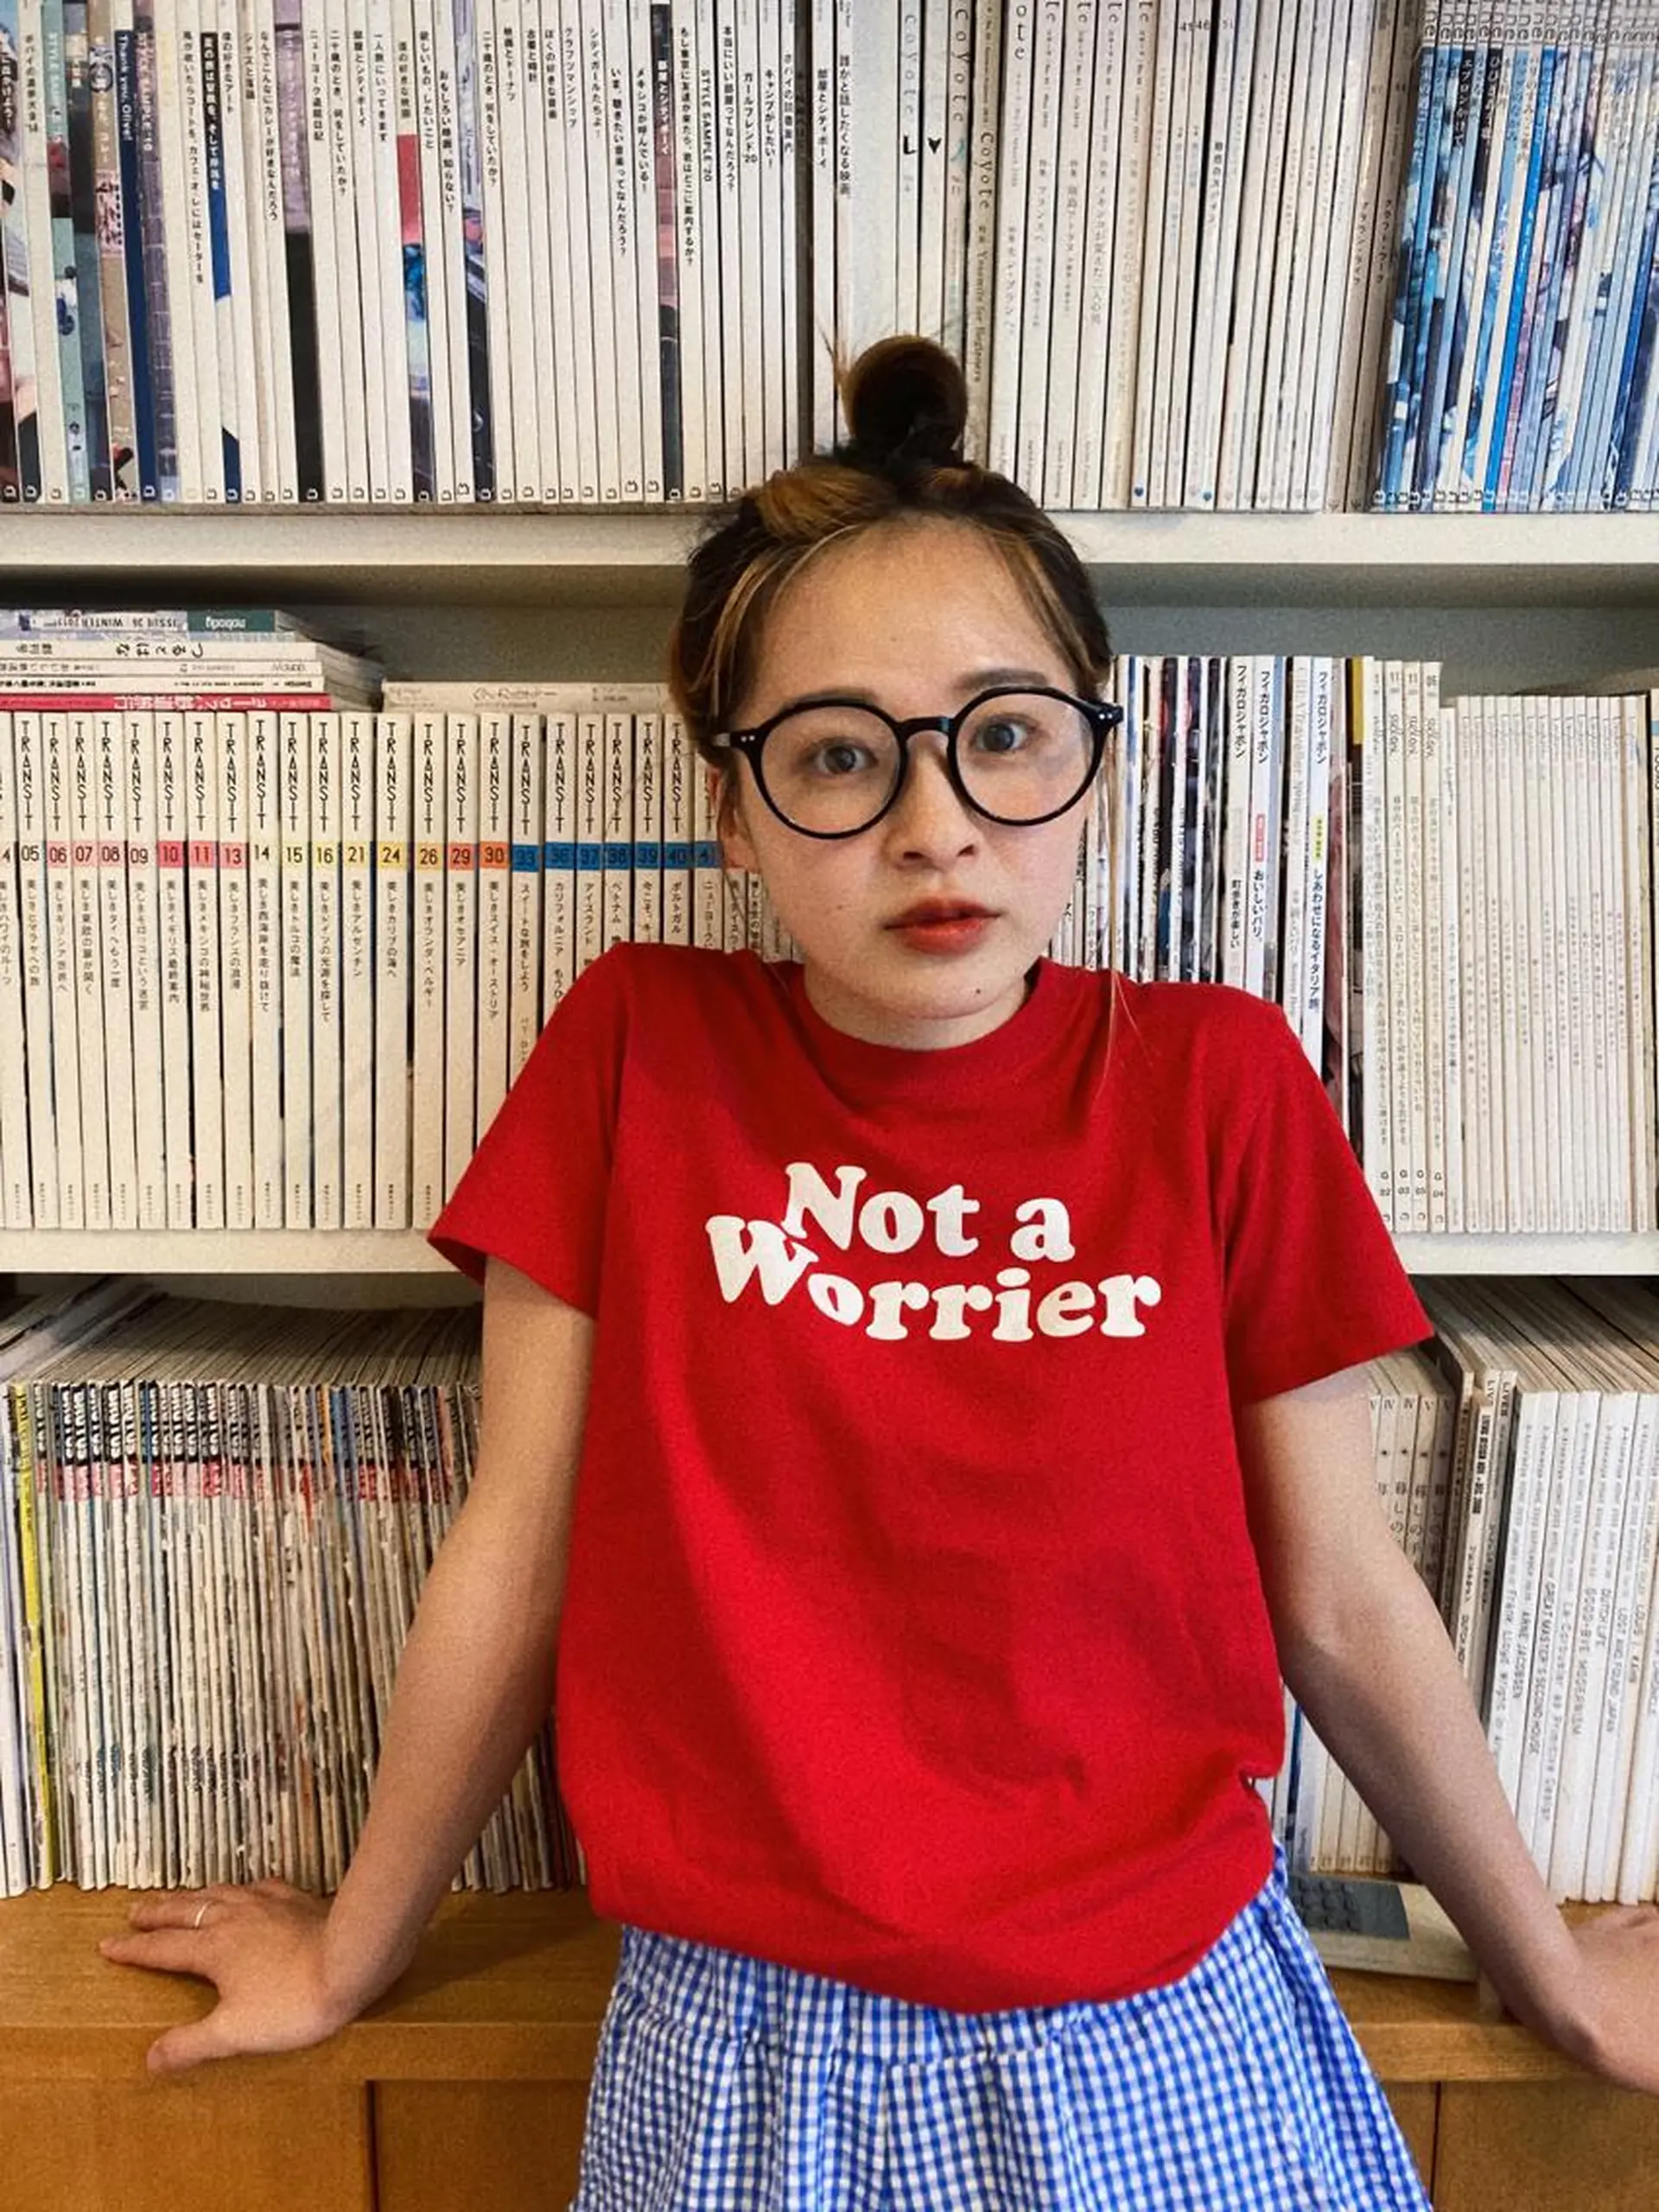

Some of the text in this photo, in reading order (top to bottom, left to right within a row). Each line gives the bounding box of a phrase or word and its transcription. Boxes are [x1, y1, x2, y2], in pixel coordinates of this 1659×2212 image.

[118, 35, 128, 76] Thank
[952, 8, 969, 123] Coyote
[122, 104, 133, 142] Olive!
[702, 111, 713, 162] SAMPLE
[974, 132, 994, 210] Coyote
[81, 618, 124, 628] WINTER
[115, 641, 204, 658] つるとはな
[205, 616, 247, 630] nobody
[1235, 664, 1247, 759] フィガロジャポン
[1258, 671, 1270, 764] フィガロジャポン
[1317, 671, 1328, 765] フィガロジャポン
[22, 720, 33, 831] TRANSIT
[48, 722, 67, 862] TRANSIT 06
[75, 720, 88, 831] TRANSIT
[102, 720, 114, 831] TRANSIT
[131, 723, 143, 833] TRANSIT
[162, 721, 179, 862] TRANSIT 10
[194, 721, 210, 862] TRANSIT 11
[224, 723, 243, 864] TRANSIT 13
[254, 719, 270, 861] TRANSIT 14
[286, 722, 303, 863] TRANSIT 15
[316, 722, 334, 863] TRANSIT 16
[350, 721, 362, 832] TRANSIT
[386, 721, 397, 833] TRANSIT
[423, 724, 434, 834] TRANSIT
[453, 723, 471, 864] TRANSIT 29
[490, 722, 500, 833] TRANSIT
[520, 725, 531, 836] TRANSIT
[554, 722, 566, 834] TRANSIT
[586, 723, 597, 835] TRANSIT
[612, 722, 623, 835] TRANSIT
[642, 722, 653, 835] TRANSIT
[671, 722, 683, 835] TRANSIT
[21, 844, 41, 862] 05
[74, 845, 92, 862] 07
[101, 845, 121, 862] 08
[130, 847, 149, 864] 09
[347, 845, 365, 862] 21
[382, 848, 401, 863] 24
[419, 849, 438, 865] 26
[484, 847, 505, 863] 30
[781, 1162, 1076, 1262] Not a
[704, 1214, 1162, 1343] Worrier
